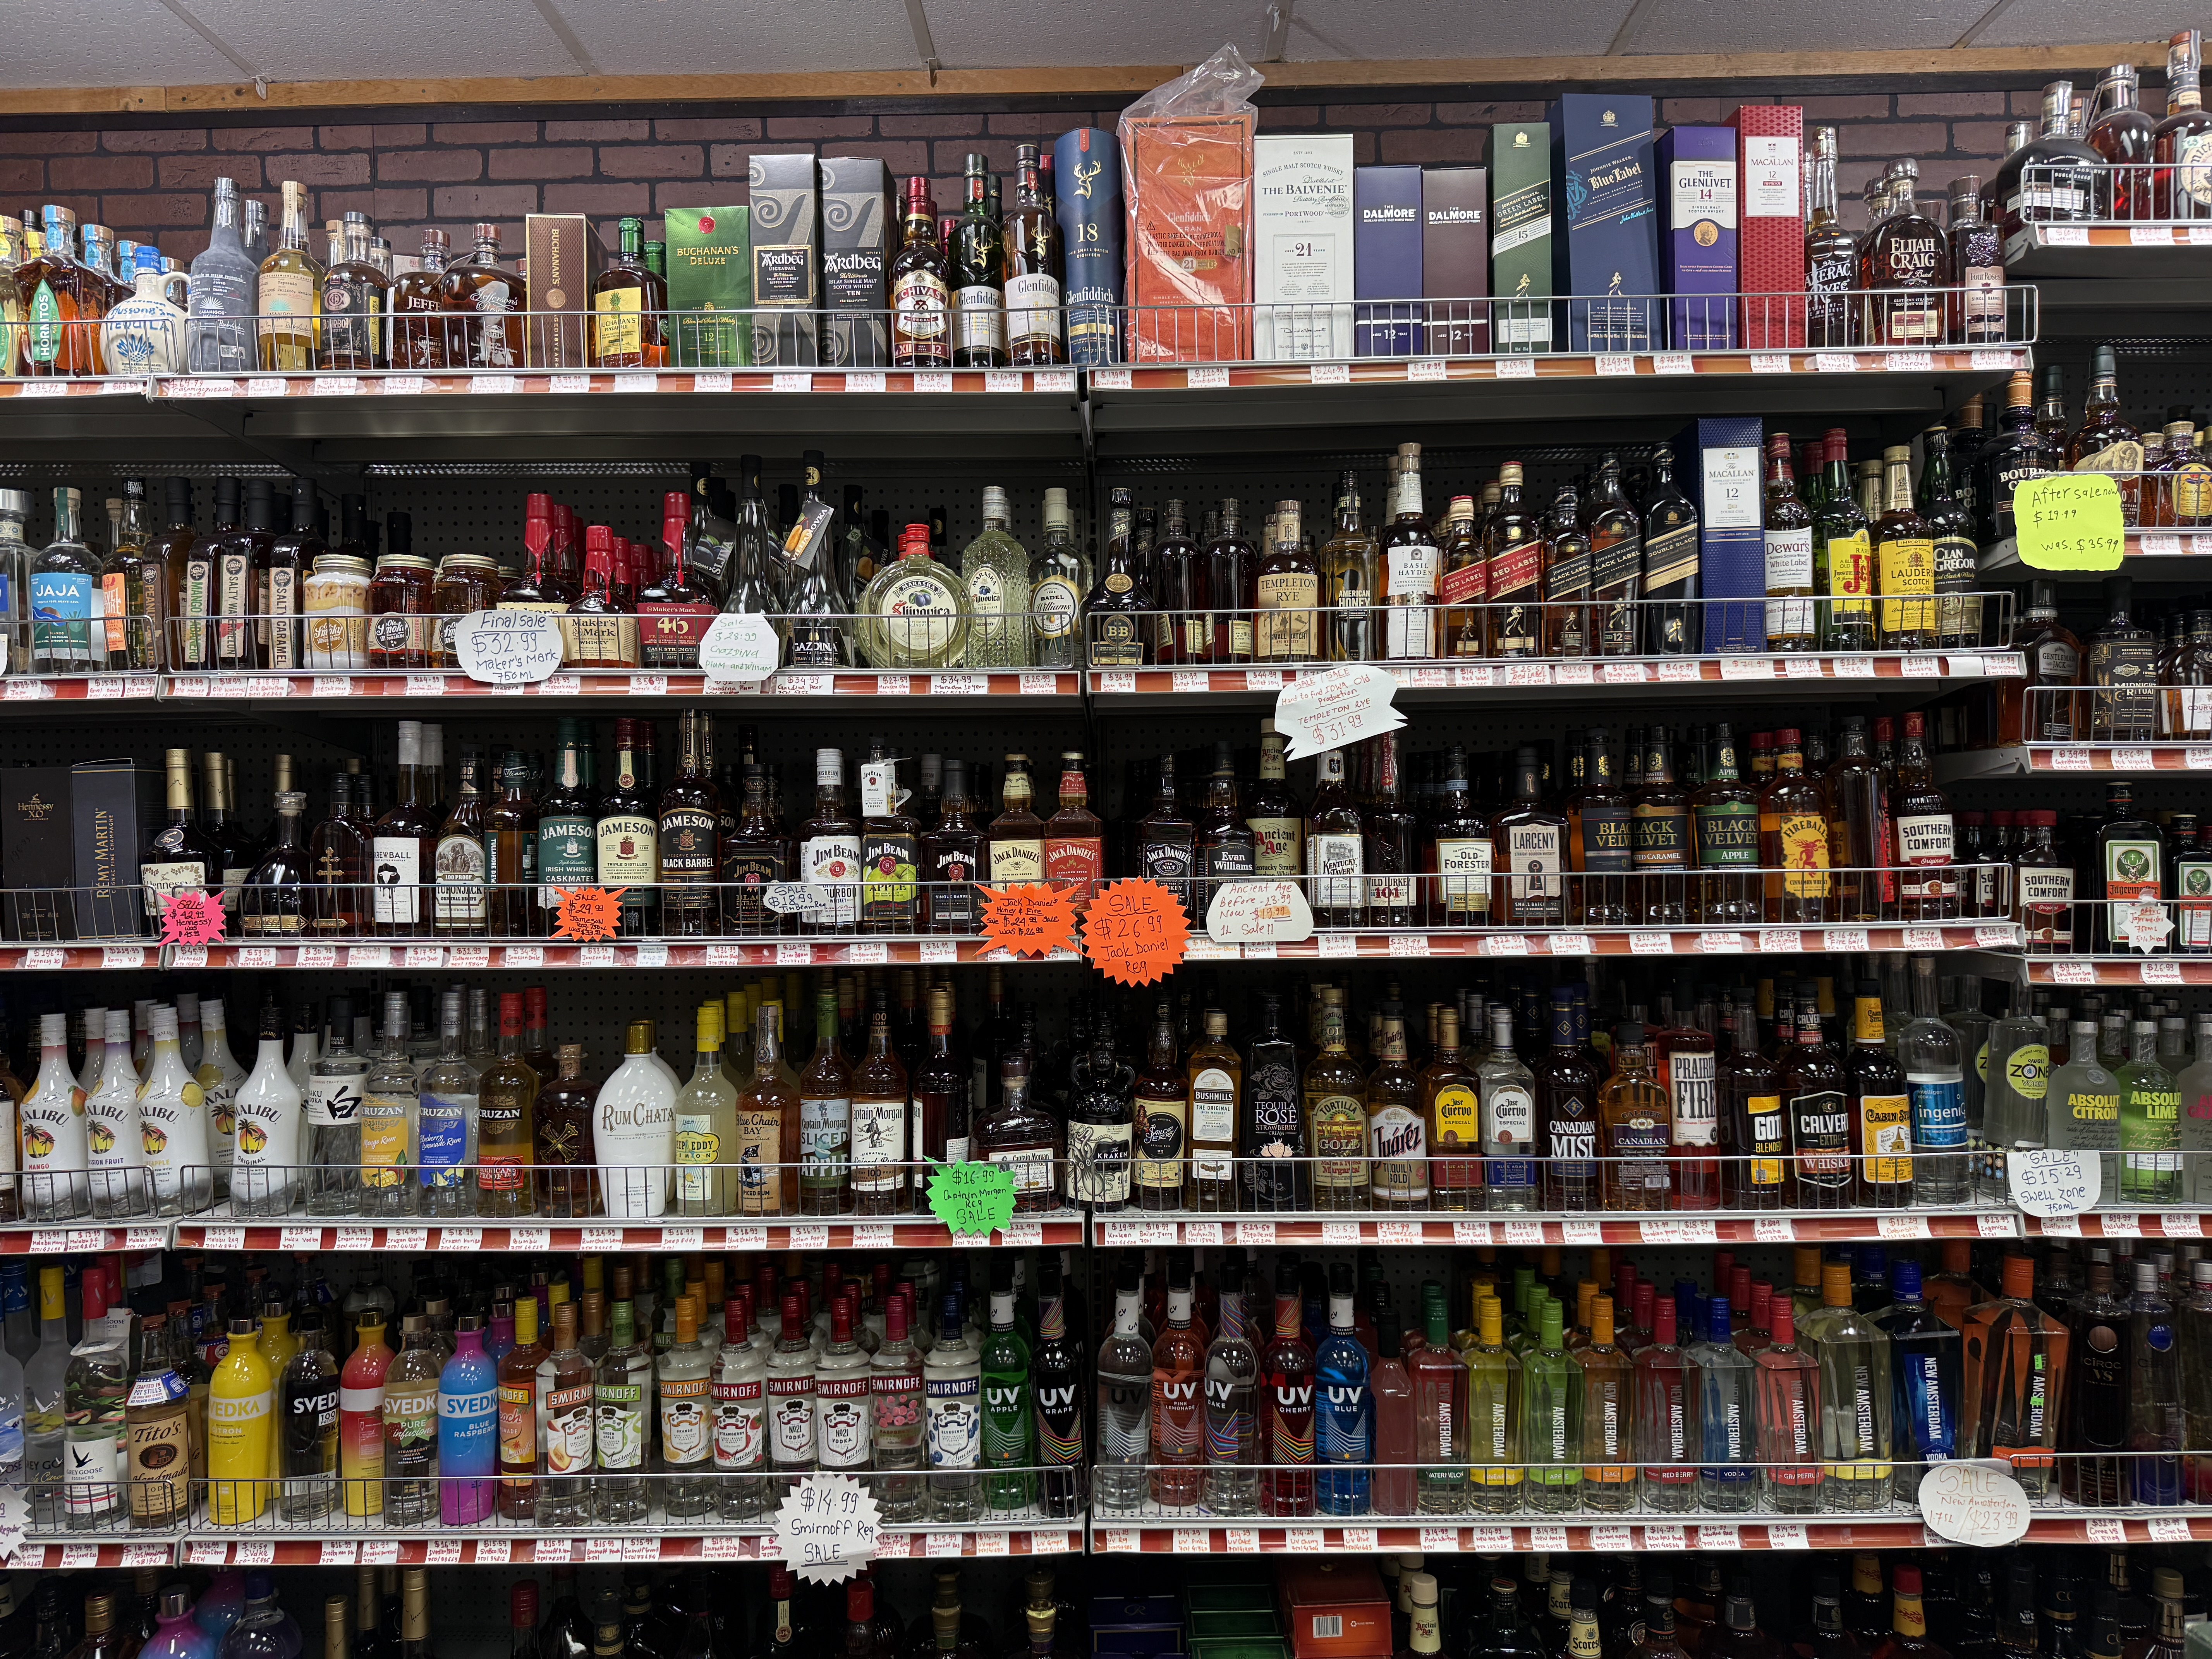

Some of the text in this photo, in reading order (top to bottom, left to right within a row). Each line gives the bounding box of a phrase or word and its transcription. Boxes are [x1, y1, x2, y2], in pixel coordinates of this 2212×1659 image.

[1588, 170, 1614, 191] Blue
[1262, 184, 1345, 195] THE BALVENIE
[1699, 189, 1712, 199] 14
[1364, 210, 1415, 219] DALMORE
[1429, 211, 1480, 220] DALMORE
[1077, 223, 1097, 243] 18
[1518, 230, 1528, 239] 15
[677, 246, 738, 256] BUCHANAN'S
[1295, 243, 1312, 257] 21
[1890, 238, 1935, 253] ELIJAH
[690, 257, 726, 265] DELUXE
[1184, 260, 1194, 269] 21
[1890, 252, 1935, 270] CRAIG
[1894, 270, 1933, 280] Small Batch
[900, 287, 940, 300] CHIVAS
[40, 294, 52, 358] HORNITOS
[1726, 488, 1738, 498] 12
[2032, 486, 2071, 507] After
[1648, 536, 1696, 558] DOUBLE BLACK
[1766, 542, 1810, 555] Dewar's
[1934, 548, 1963, 559] CLAN
[1934, 557, 1976, 571] GREGOR
[1492, 567, 1511, 578] RED
[1891, 568, 1933, 580] LAUDER'S
[902, 580, 935, 591] MARASKA
[1261, 579, 1316, 590] TEMPLETON
[1902, 578, 1930, 586] SCOTCH
[36, 584, 80, 597] JAJA
[1276, 591, 1300, 601] RYE
[1036, 602, 1071, 612] Williams
[481, 611, 546, 629] Final sale
[572, 619, 616, 628] Maker's
[657, 617, 689, 636] 46
[720, 618, 747, 627] Sale
[582, 628, 616, 637] Mark
[476, 649, 559, 671] Maker's Mark
[2043, 653, 2076, 661] GENTLEMAN
[1281, 674, 1370, 706] Hard to find IOWA Old
[1297, 697, 1371, 725] TEMPLETON RYE
[18, 802, 54, 812] Hennessy
[662, 815, 714, 831] JAMESON
[1707, 819, 1756, 832] BLACK
[543, 825, 597, 841] JAMESON
[601, 823, 655, 838] JAMESON
[1902, 823, 1951, 838] SOUTHERN
[1255, 827, 1296, 848] Ancient
[1514, 832, 1554, 849] LARCENY
[1704, 832, 1757, 845] VELVET
[1907, 837, 1951, 850] COMFORT
[813, 844, 860, 867] JIM BEAM
[866, 843, 908, 861] JIM BEAM
[1221, 852, 1245, 861] Evan
[1460, 851, 1479, 859] OLD
[1721, 851, 1748, 860] APPLE
[663, 858, 714, 868] BLACK BARREL
[1444, 859, 1490, 869] FORESTER
[2025, 875, 2070, 887] SOUTHERN
[775, 886, 807, 896] SALE
[1229, 883, 1292, 893] Ancient Age
[2028, 887, 2068, 897] COMFORT
[1000, 898, 1022, 907] Jack
[1108, 894, 1152, 914] SALE
[1219, 896, 1256, 907] Before
[1135, 938, 1169, 953] Daniel
[872, 1013, 886, 1021] 100
[327, 1085, 361, 1120] 白
[1195, 1091, 1233, 1101] BUSHMILLS
[2068, 1093, 2120, 1108] ABSOLUT
[362, 1106, 405, 1116] CRUZAN
[420, 1106, 462, 1116] CRUZAN
[1254, 1102, 1295, 1111] TEQUILA
[1320, 1101, 1357, 1116] TORTILLA
[1441, 1104, 1472, 1118] Cuervo
[2073, 1106, 2118, 1120] CITRON
[2147, 1106, 2177, 1119] LIME
[1255, 1109, 1297, 1125] ROSE
[1865, 1109, 1898, 1123] CABIN
[1549, 1120, 1595, 1133] CANADIAN
[801, 1131, 848, 1146] SLICED
[1319, 1139, 1360, 1150] GOLD
[1819, 1136, 1843, 1146] EXTRA
[691, 1140, 714, 1151] EDDY
[1550, 1135, 1595, 1158] MIST
[1097, 1152, 1128, 1160] KRAKEN
[952, 1169, 994, 1185] $16.99
[2021, 1165, 2082, 1185] $15.29
[979, 1187, 1006, 1199] Morgan
[956, 1208, 996, 1224] SALE
[987, 1386, 1020, 1404] UV
[1277, 1386, 1312, 1404] UV
[1328, 1386, 1363, 1404] UV
[401, 1421, 426, 1430] PURE
[454, 1424, 496, 1437] RASPBERRY
[469, 1421, 489, 1429] BLUE
[1439, 1401, 1452, 1456] AMSTERDAM
[1553, 1406, 1565, 1459] AMSTERDAM
[1939, 1465, 2001, 1495] SALE
[800, 1487, 859, 1515] $14.99
[791, 1518, 874, 1538] Smirnoff Reg
[804, 1543, 840, 1563] SALE
